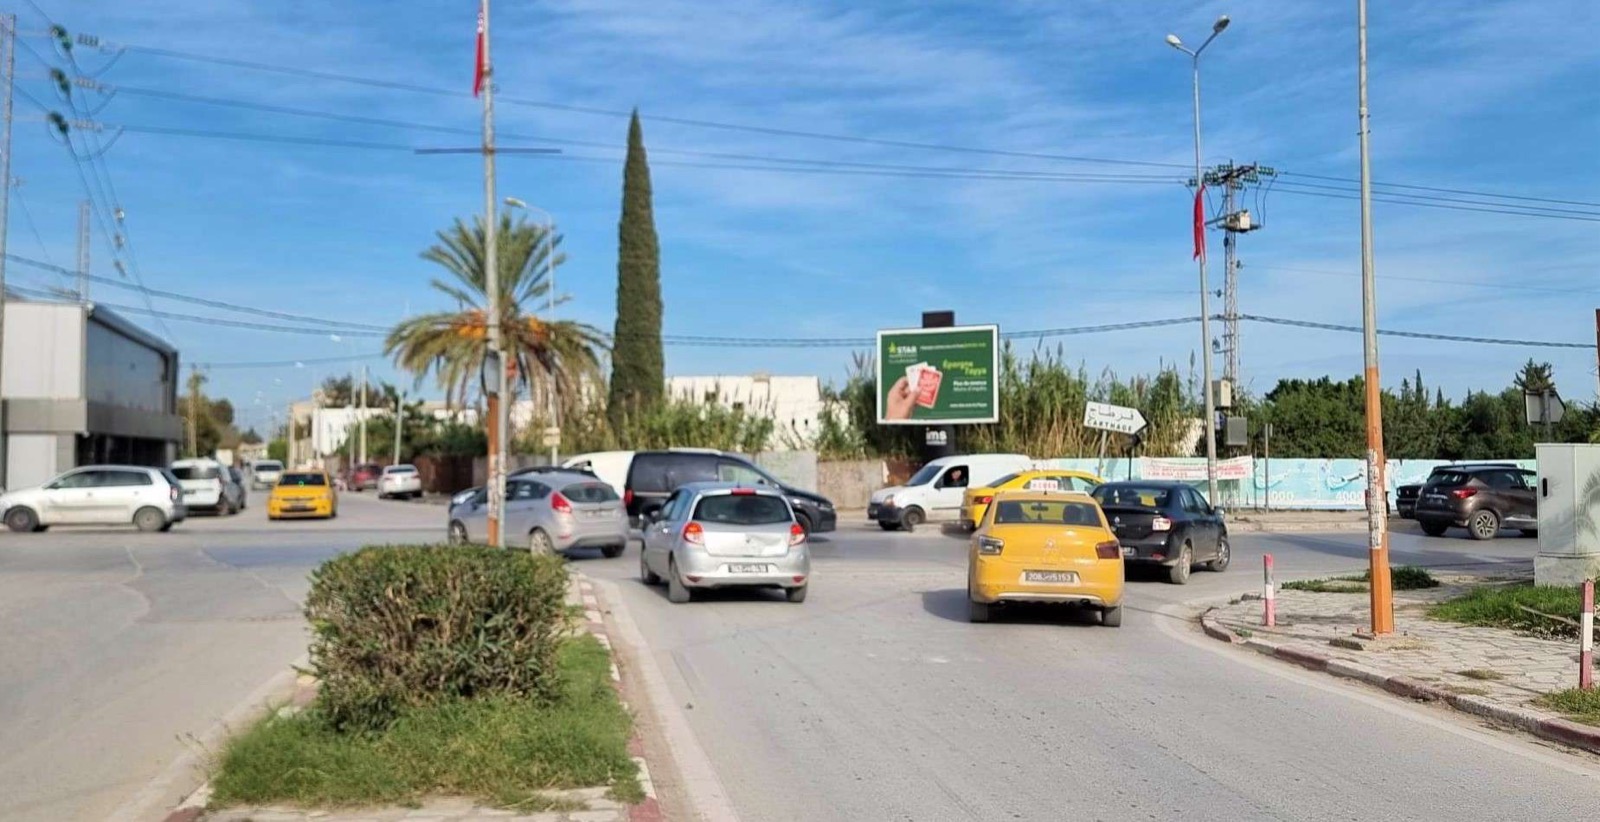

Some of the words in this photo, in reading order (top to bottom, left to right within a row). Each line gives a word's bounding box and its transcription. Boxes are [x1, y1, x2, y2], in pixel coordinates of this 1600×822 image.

[896, 345, 917, 354] STAR
[1087, 420, 1132, 431] CARTHAGE
[925, 427, 947, 441] ims
